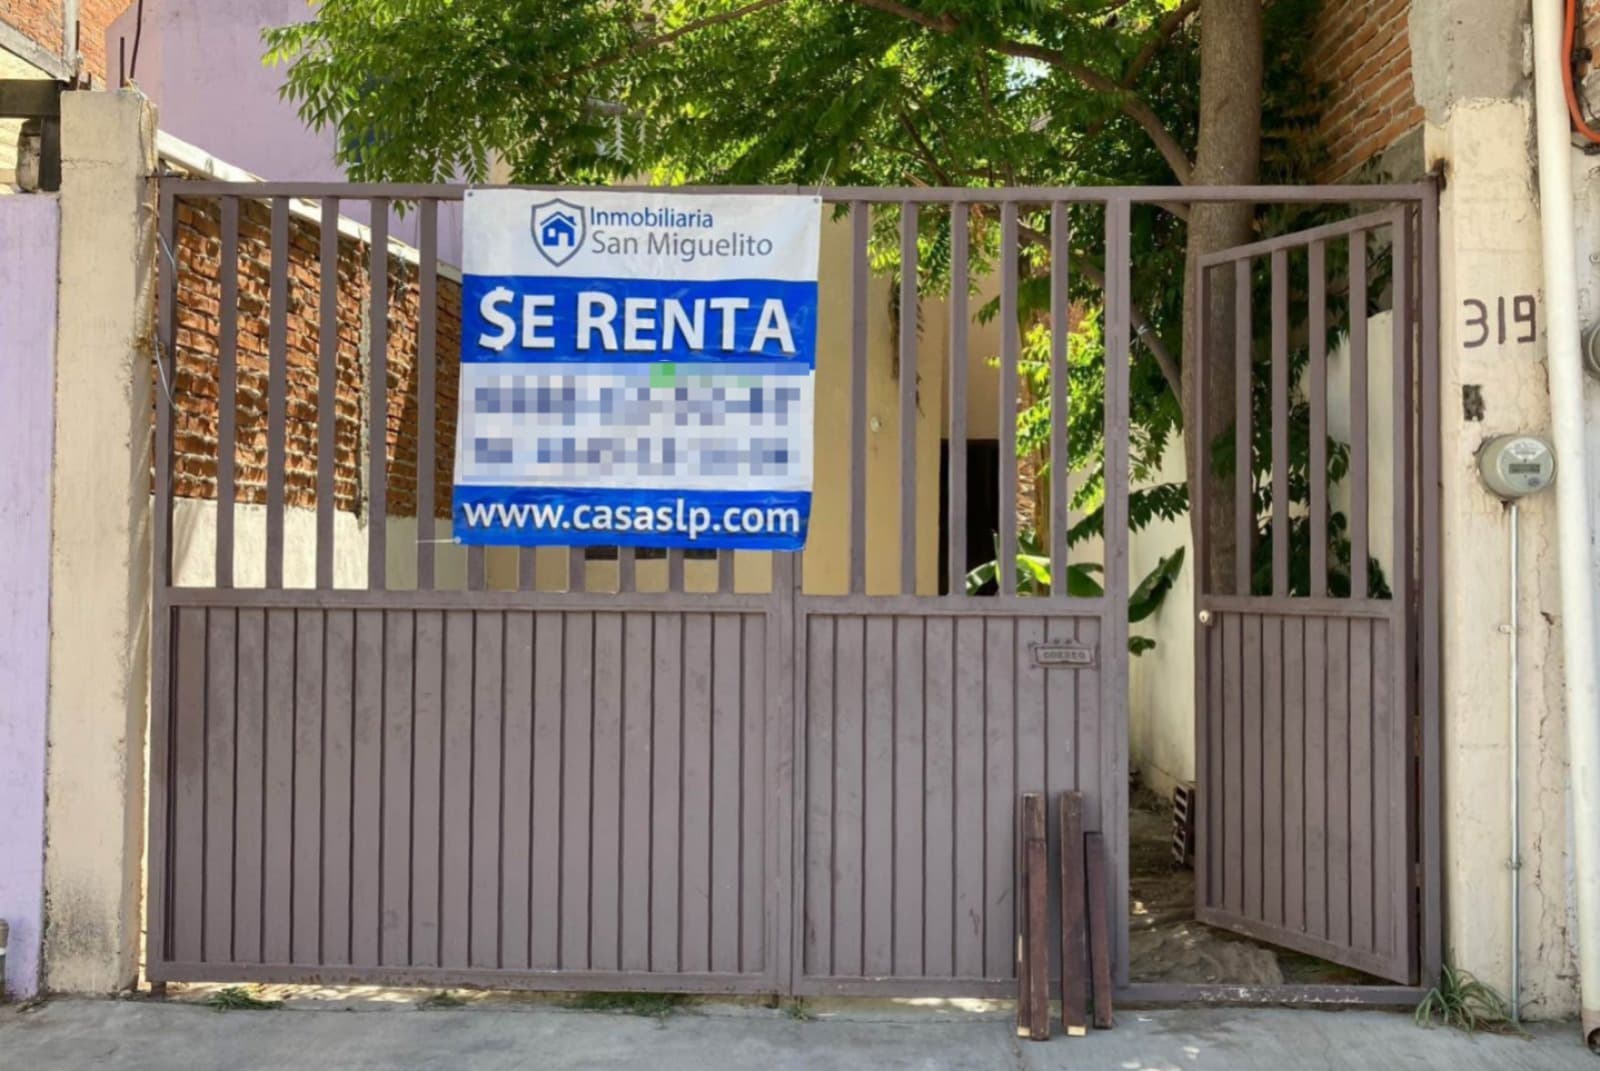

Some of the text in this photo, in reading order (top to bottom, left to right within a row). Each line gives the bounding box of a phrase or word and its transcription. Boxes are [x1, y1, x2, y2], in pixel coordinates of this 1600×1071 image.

[590, 206, 714, 228] Inmobiliaria
[591, 230, 773, 262] San Miguelito
[576, 291, 796, 354] RENTA
[1463, 295, 1536, 348] 319
[463, 498, 800, 540] www.casaslp.com
